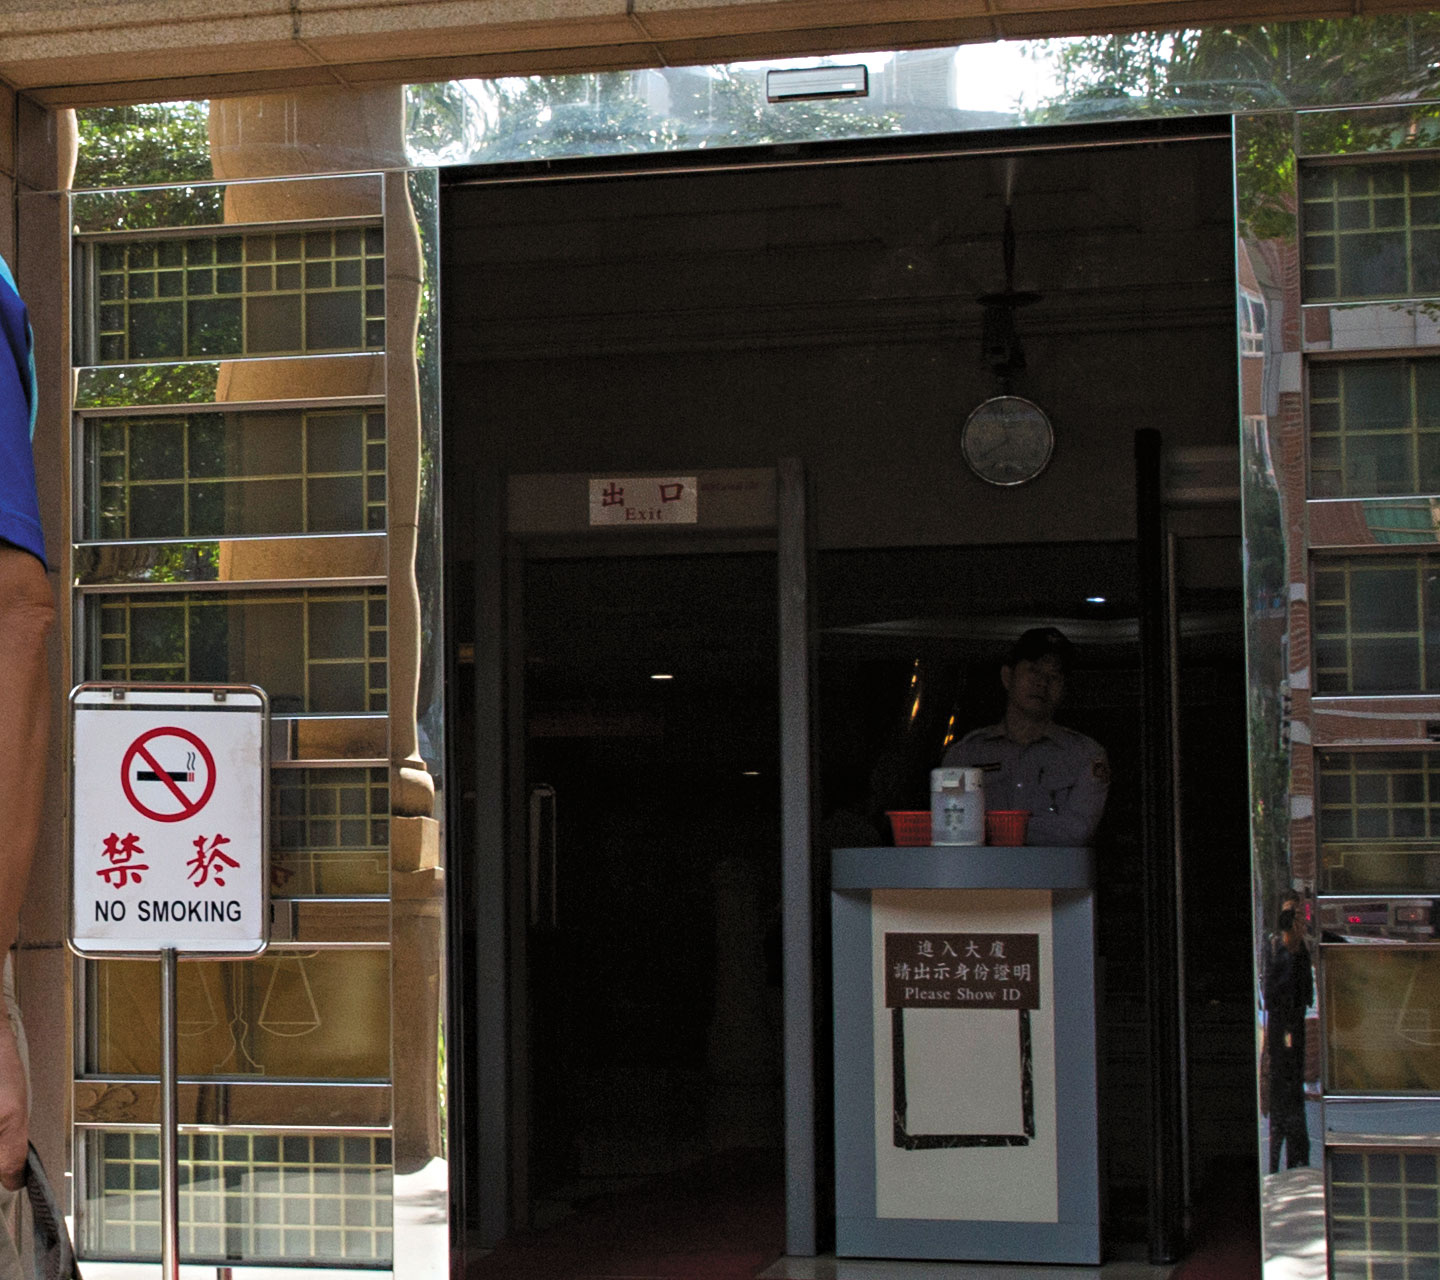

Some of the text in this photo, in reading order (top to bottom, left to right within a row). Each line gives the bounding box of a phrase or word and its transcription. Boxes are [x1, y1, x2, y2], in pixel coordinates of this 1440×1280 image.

[601, 481, 684, 508] 出口
[625, 507, 662, 521] Exit
[96, 832, 241, 890] 禁菸
[94, 900, 242, 922] NO SMOKING
[905, 987, 1021, 1001] Please Show ID
